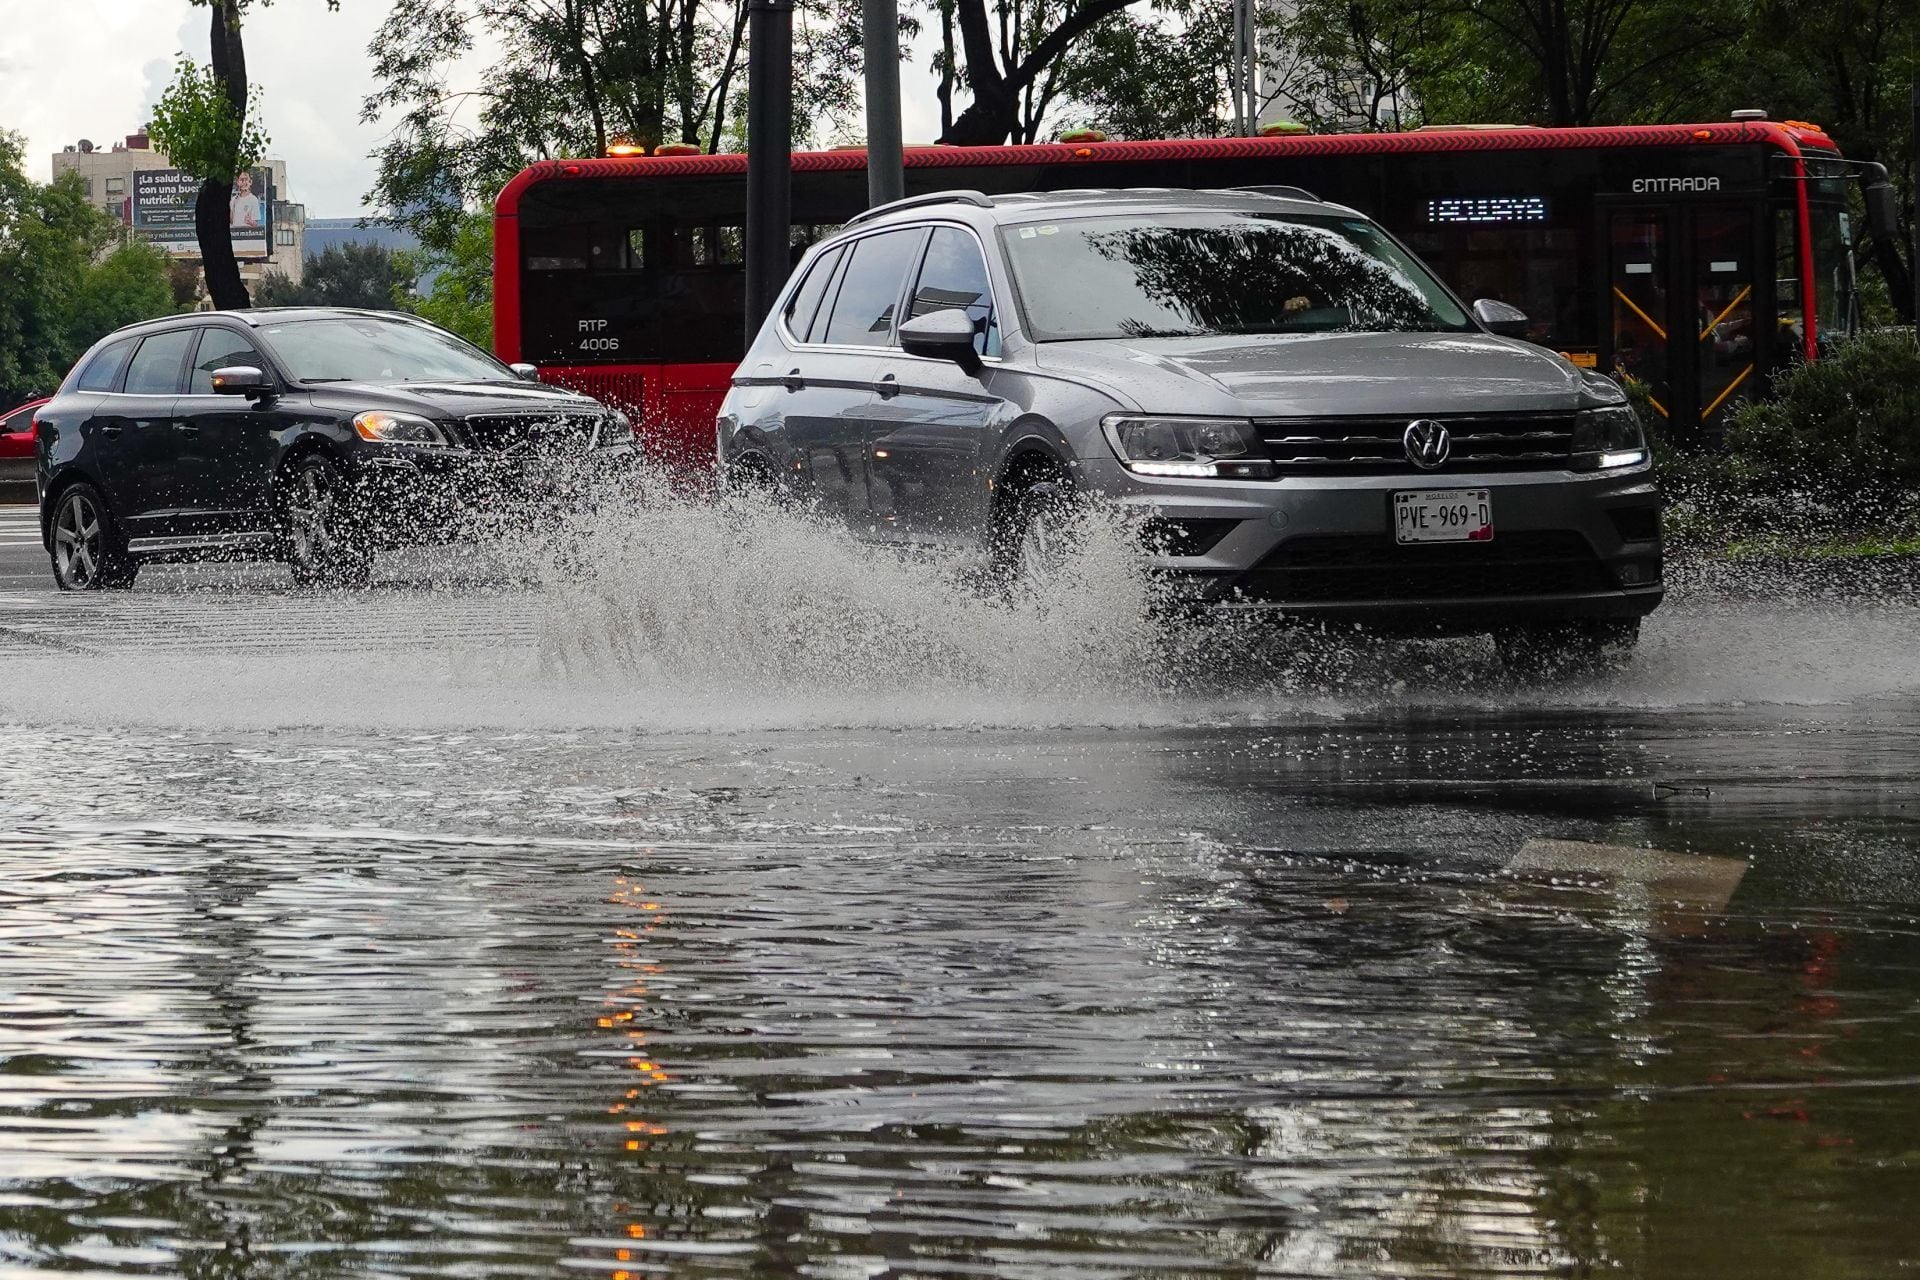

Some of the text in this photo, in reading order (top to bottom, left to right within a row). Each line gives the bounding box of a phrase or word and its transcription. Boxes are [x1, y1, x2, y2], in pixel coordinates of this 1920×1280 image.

[154, 173, 180, 183] salud
[139, 186, 157, 194] con
[158, 186, 177, 194] una
[1632, 177, 1720, 193] ENTRADA
[578, 319, 608, 332] RTP
[579, 338, 620, 350] 4006
[1400, 502, 1489, 529] PVE-969-D
